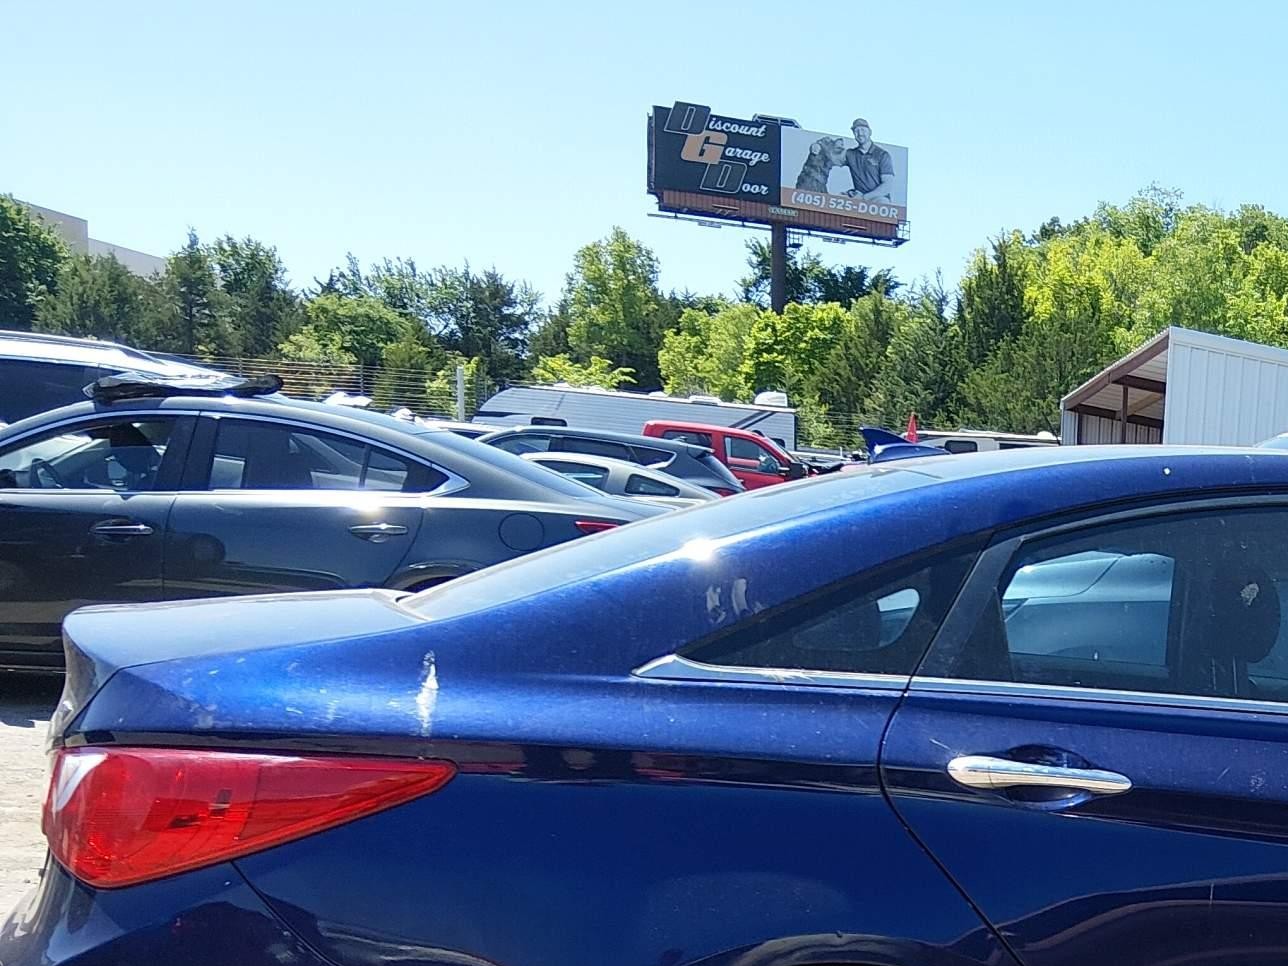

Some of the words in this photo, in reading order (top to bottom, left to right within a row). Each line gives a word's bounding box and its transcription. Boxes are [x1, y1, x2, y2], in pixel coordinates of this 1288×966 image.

[664, 101, 767, 137] Discount
[680, 130, 770, 166] Garage
[700, 160, 769, 195] Door
[791, 191, 825, 208] (405)
[829, 198, 898, 218] 525-DOOR
